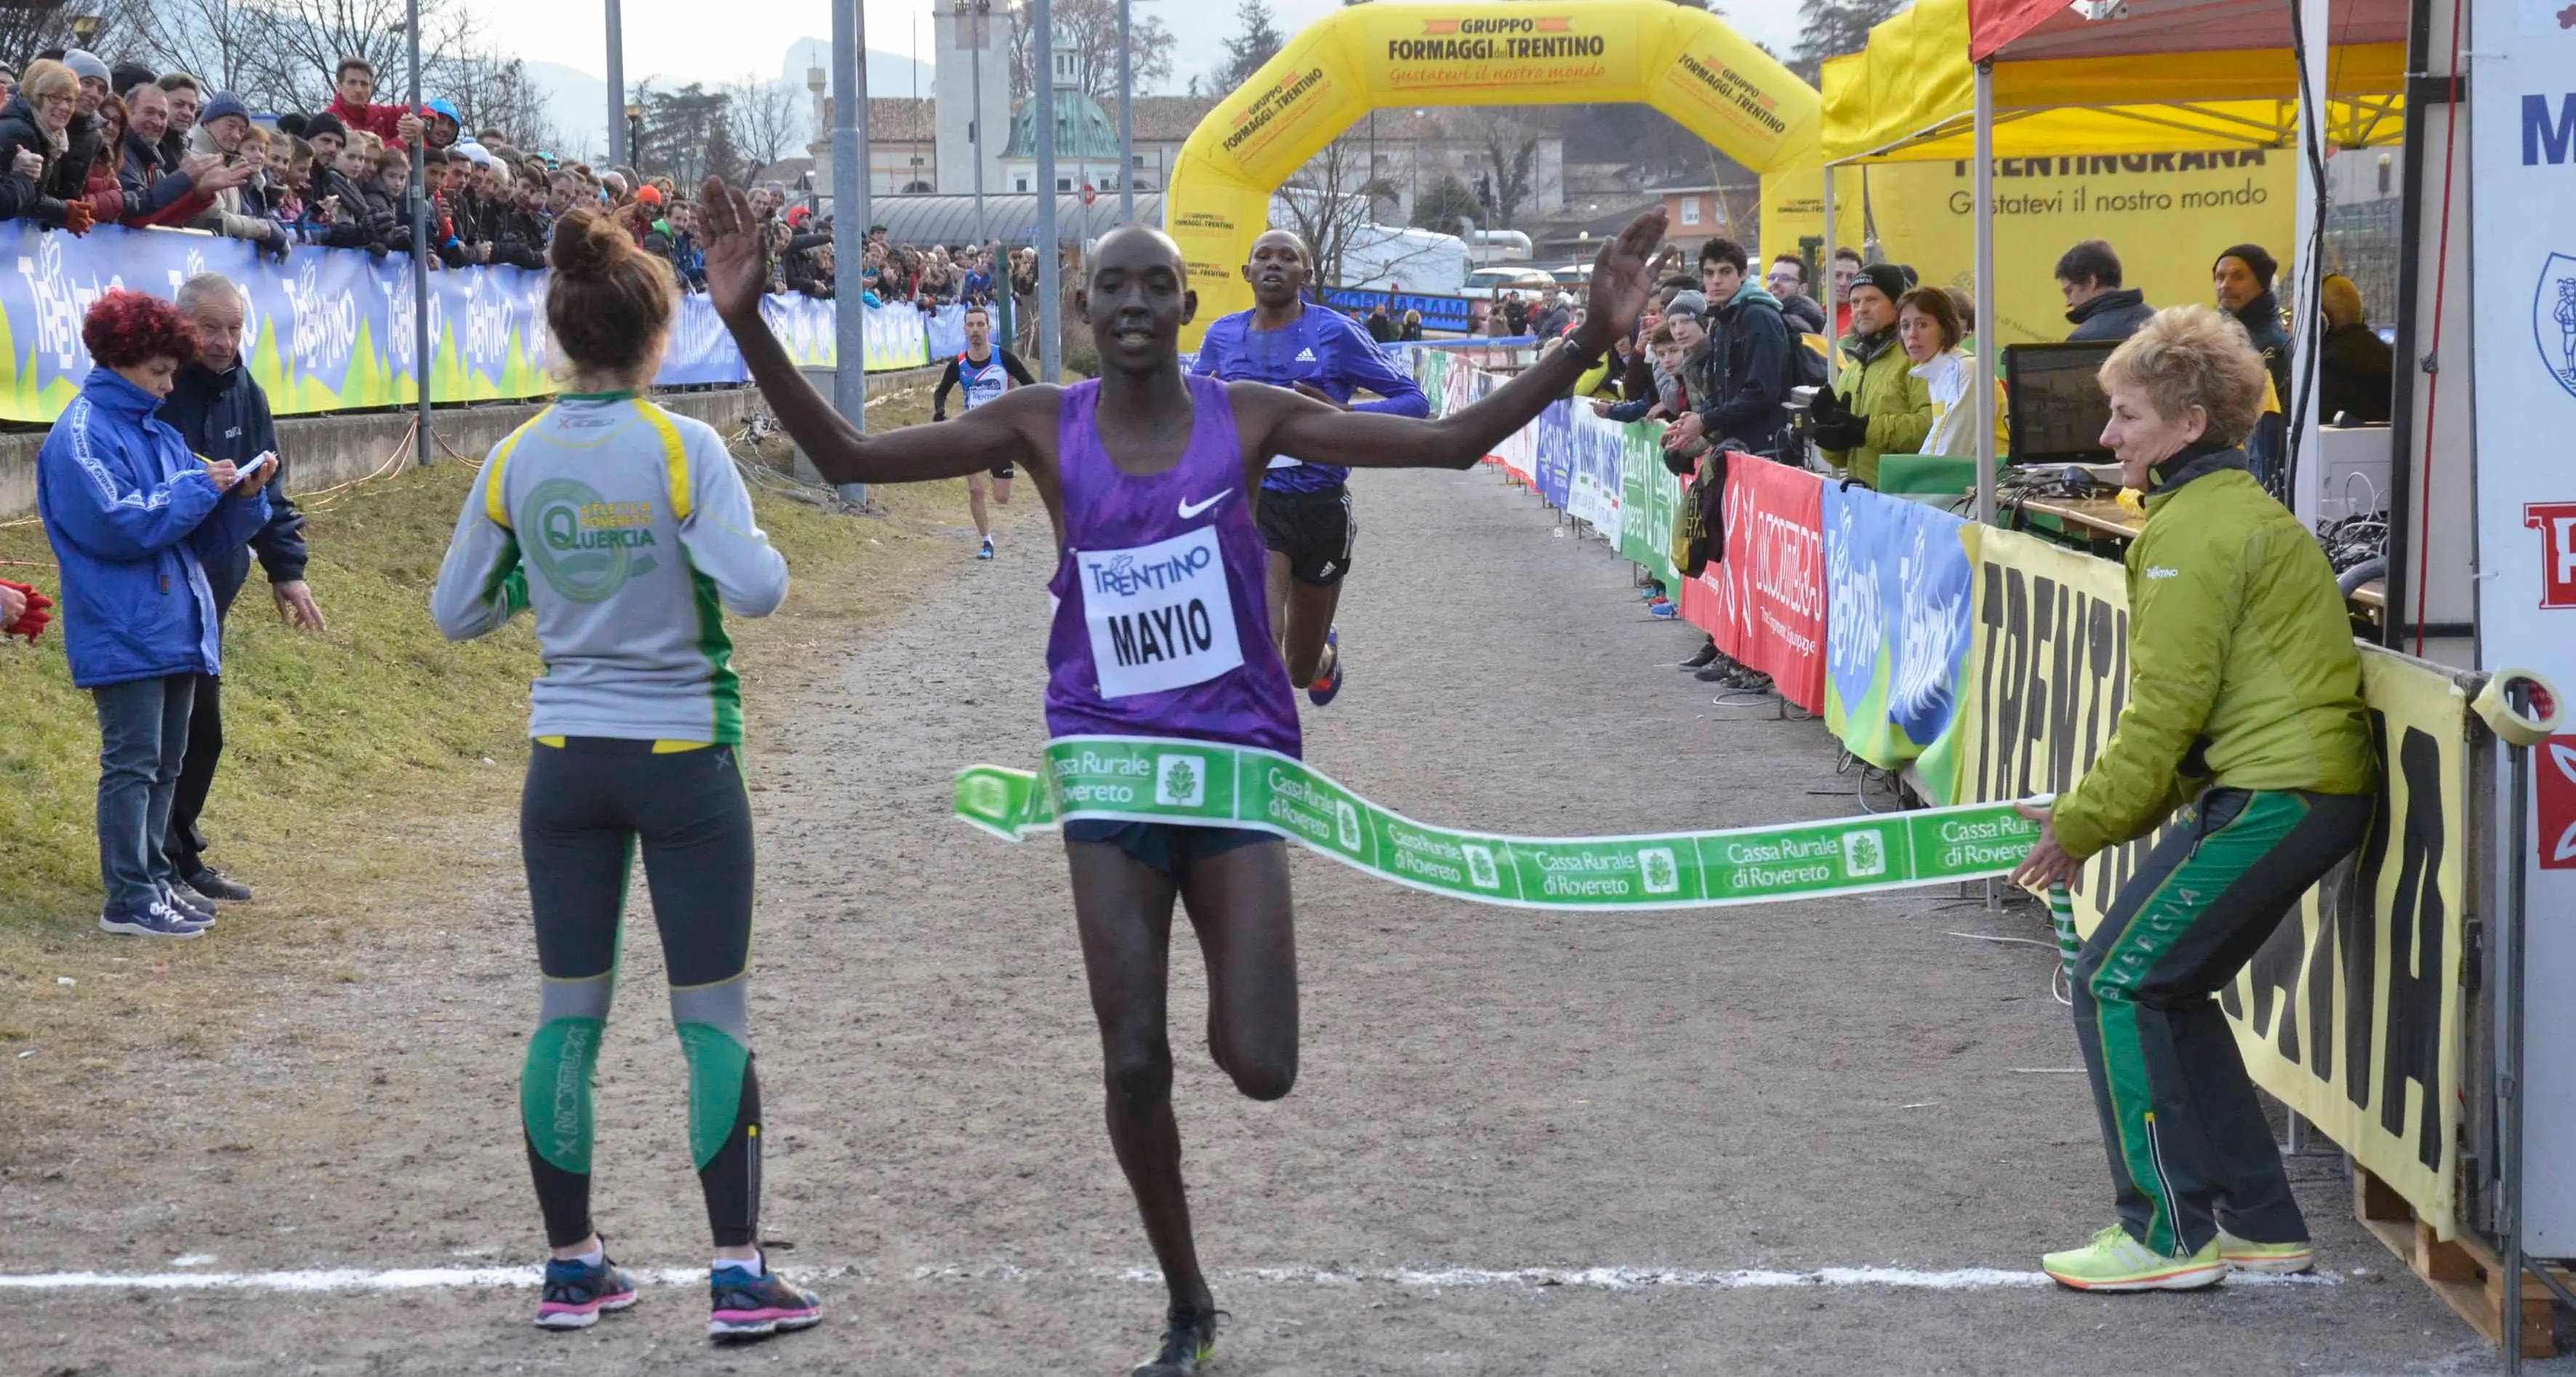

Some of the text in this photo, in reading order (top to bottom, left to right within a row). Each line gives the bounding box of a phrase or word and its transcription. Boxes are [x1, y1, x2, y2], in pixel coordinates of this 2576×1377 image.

[1461, 18, 1533, 34] GRUPPO
[1389, 39, 1493, 60] FORMAGGI
[1507, 36, 1605, 58] TRENTINO
[1477, 64, 1489, 81] il
[1493, 67, 1543, 81] nostro
[1548, 61, 1605, 78] mondo
[1722, 69, 1760, 98] GRUPPO
[1248, 84, 1283, 116] GRUPPO
[1678, 53, 1733, 97] FORMAGGI
[1735, 92, 1786, 134] TRENTINO
[1222, 107, 1274, 152] FORMAGGI
[1275, 67, 1323, 110] TRENTINO
[2074, 185, 2086, 212] il
[2095, 190, 2172, 212] nostro
[2180, 177, 2268, 209] mondo
[282, 278, 356, 369] TRENTINO
[1088, 545, 1210, 597] TRENTINO
[1107, 598, 1212, 667] MAYIO
[1082, 751, 1150, 776] Rurale
[1941, 821, 1998, 842] Cassa
[1536, 850, 1635, 871] Cassa Rurale
[1728, 835, 1838, 864] Cassa Rurale
[1946, 846, 1962, 867] di
[1544, 875, 1629, 895] di Rovereto
[1733, 865, 1829, 888] di Rovereto
